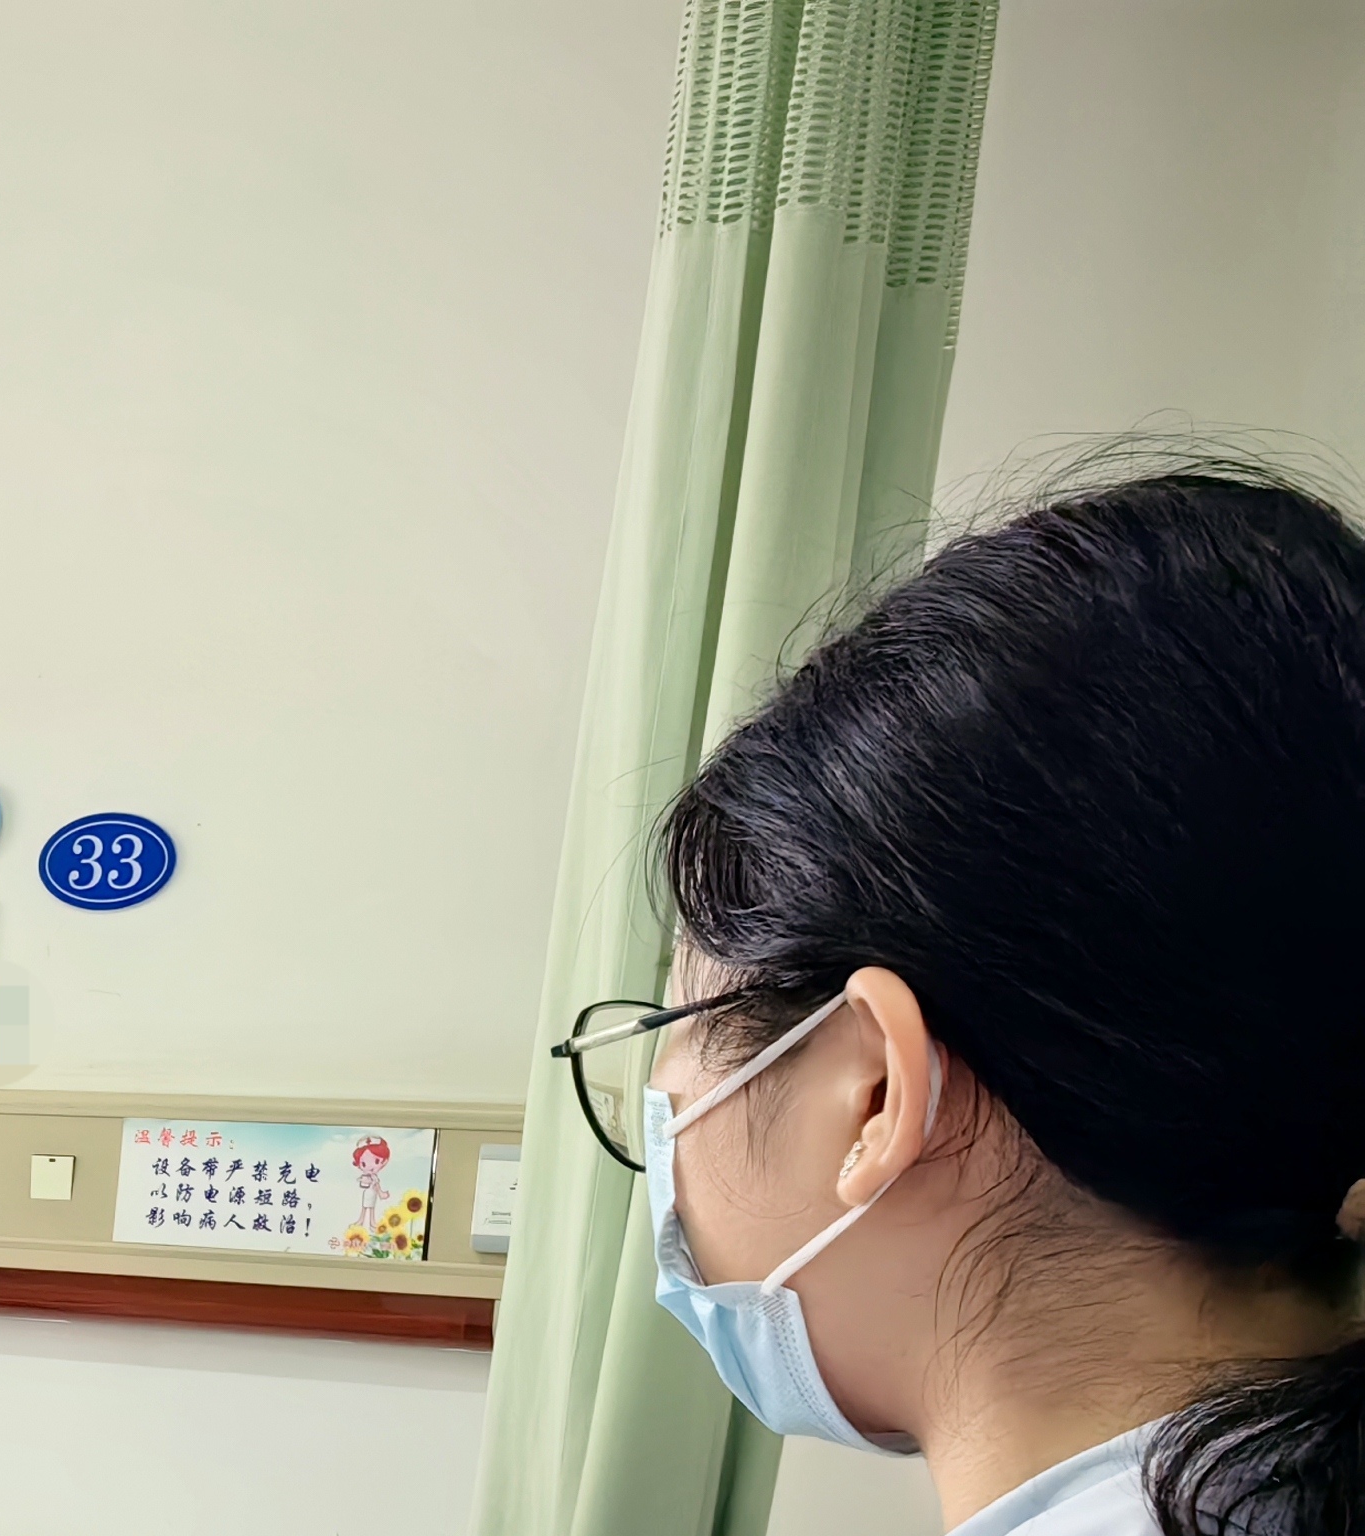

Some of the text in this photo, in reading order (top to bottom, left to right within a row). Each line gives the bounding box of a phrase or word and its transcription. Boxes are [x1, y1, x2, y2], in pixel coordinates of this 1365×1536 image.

[68, 834, 143, 890] 33
[151, 1156, 321, 1185] 设备带严禁充电
